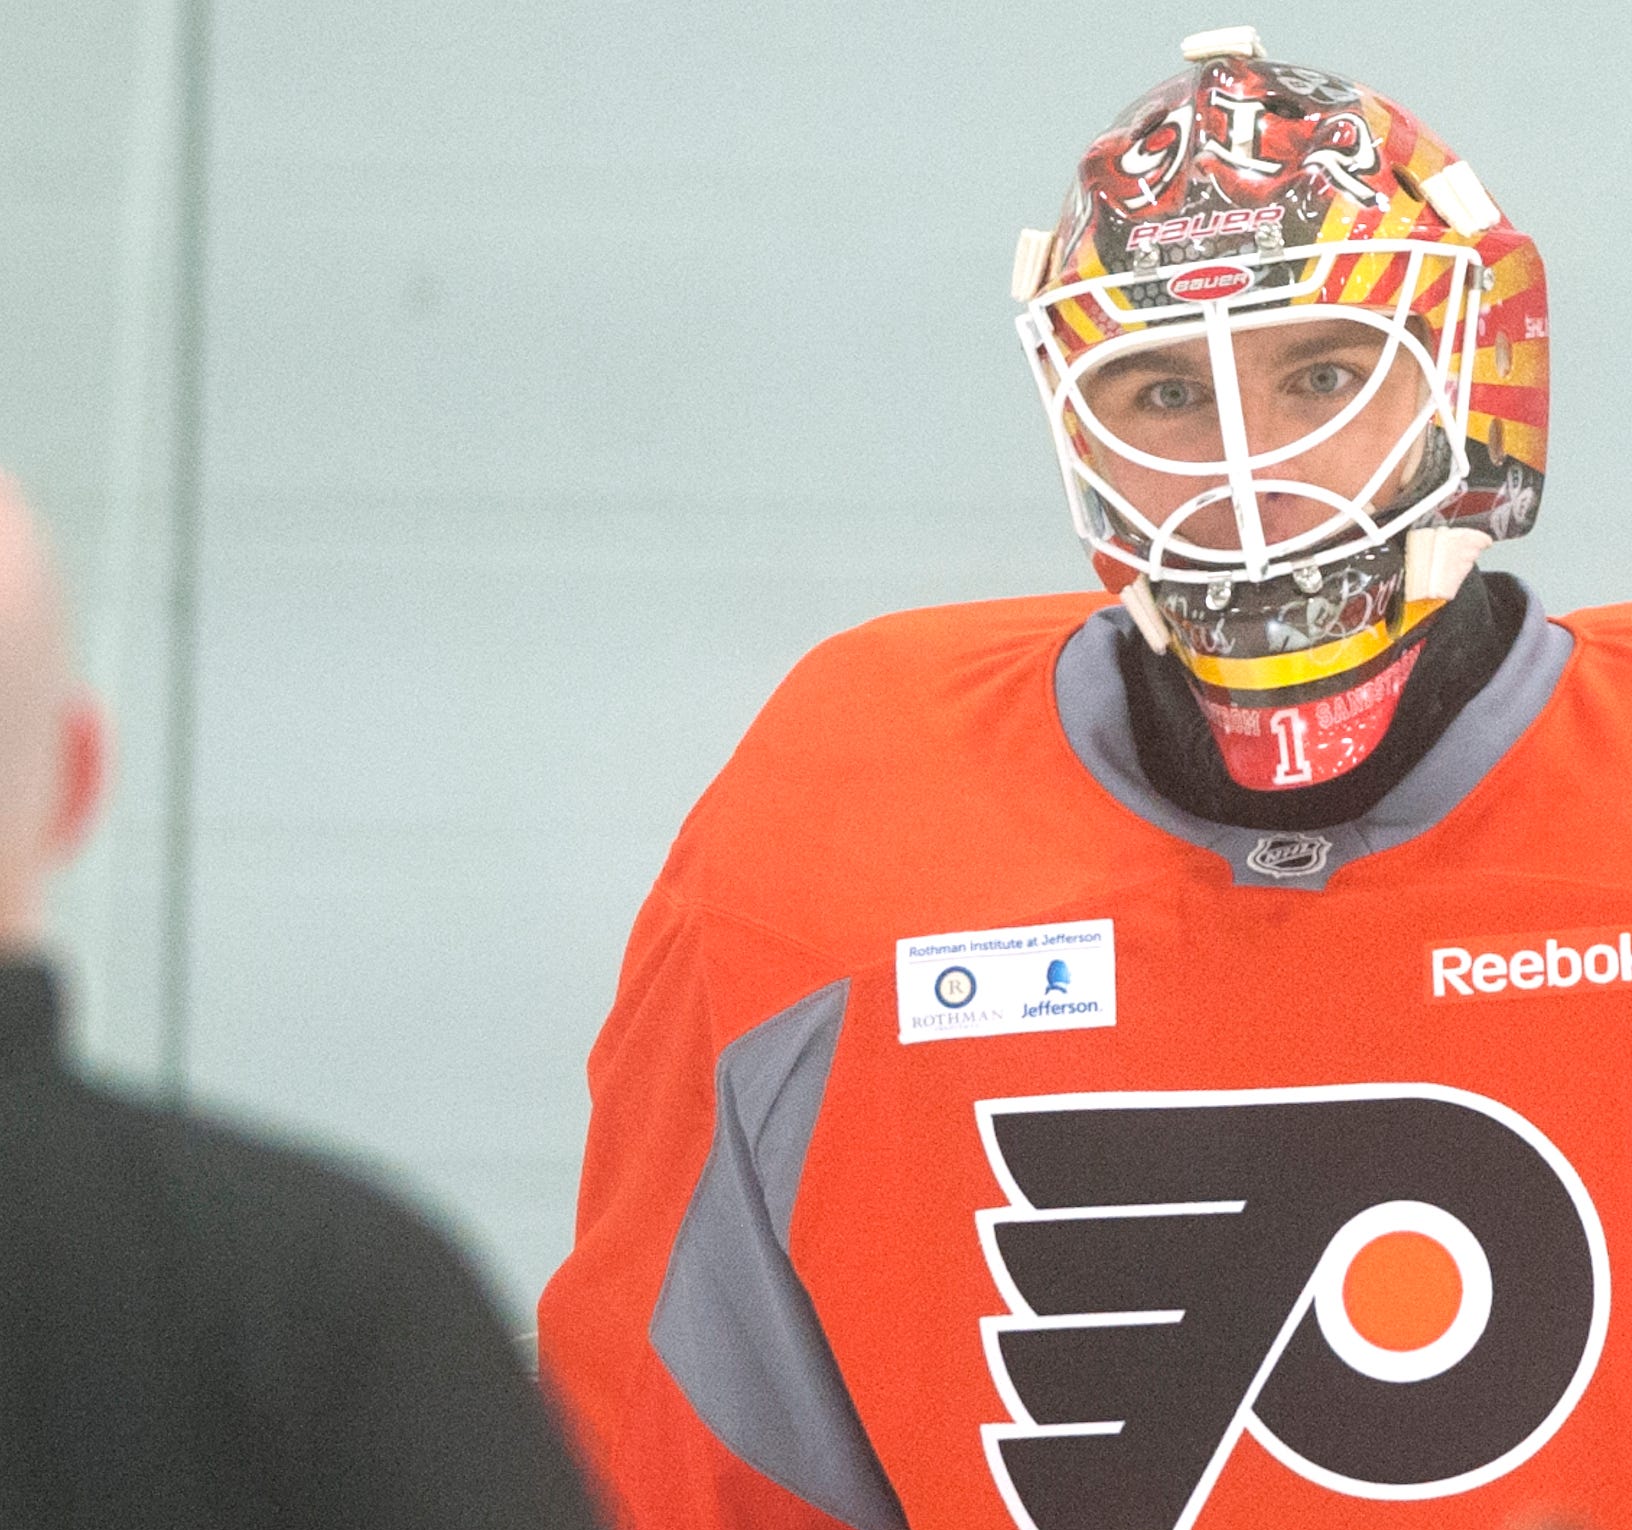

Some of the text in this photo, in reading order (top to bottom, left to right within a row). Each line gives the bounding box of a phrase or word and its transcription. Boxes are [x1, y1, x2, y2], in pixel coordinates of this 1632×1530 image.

[1173, 273, 1249, 293] BAUER
[1270, 708, 1312, 785] 1
[909, 943, 966, 957] Rothman
[1027, 937, 1038, 947] at
[1041, 932, 1102, 946] Jefferson
[948, 979, 963, 995] R
[1022, 1000, 1099, 1018] Jefferson
[912, 1010, 1003, 1029] ROTHMAN
